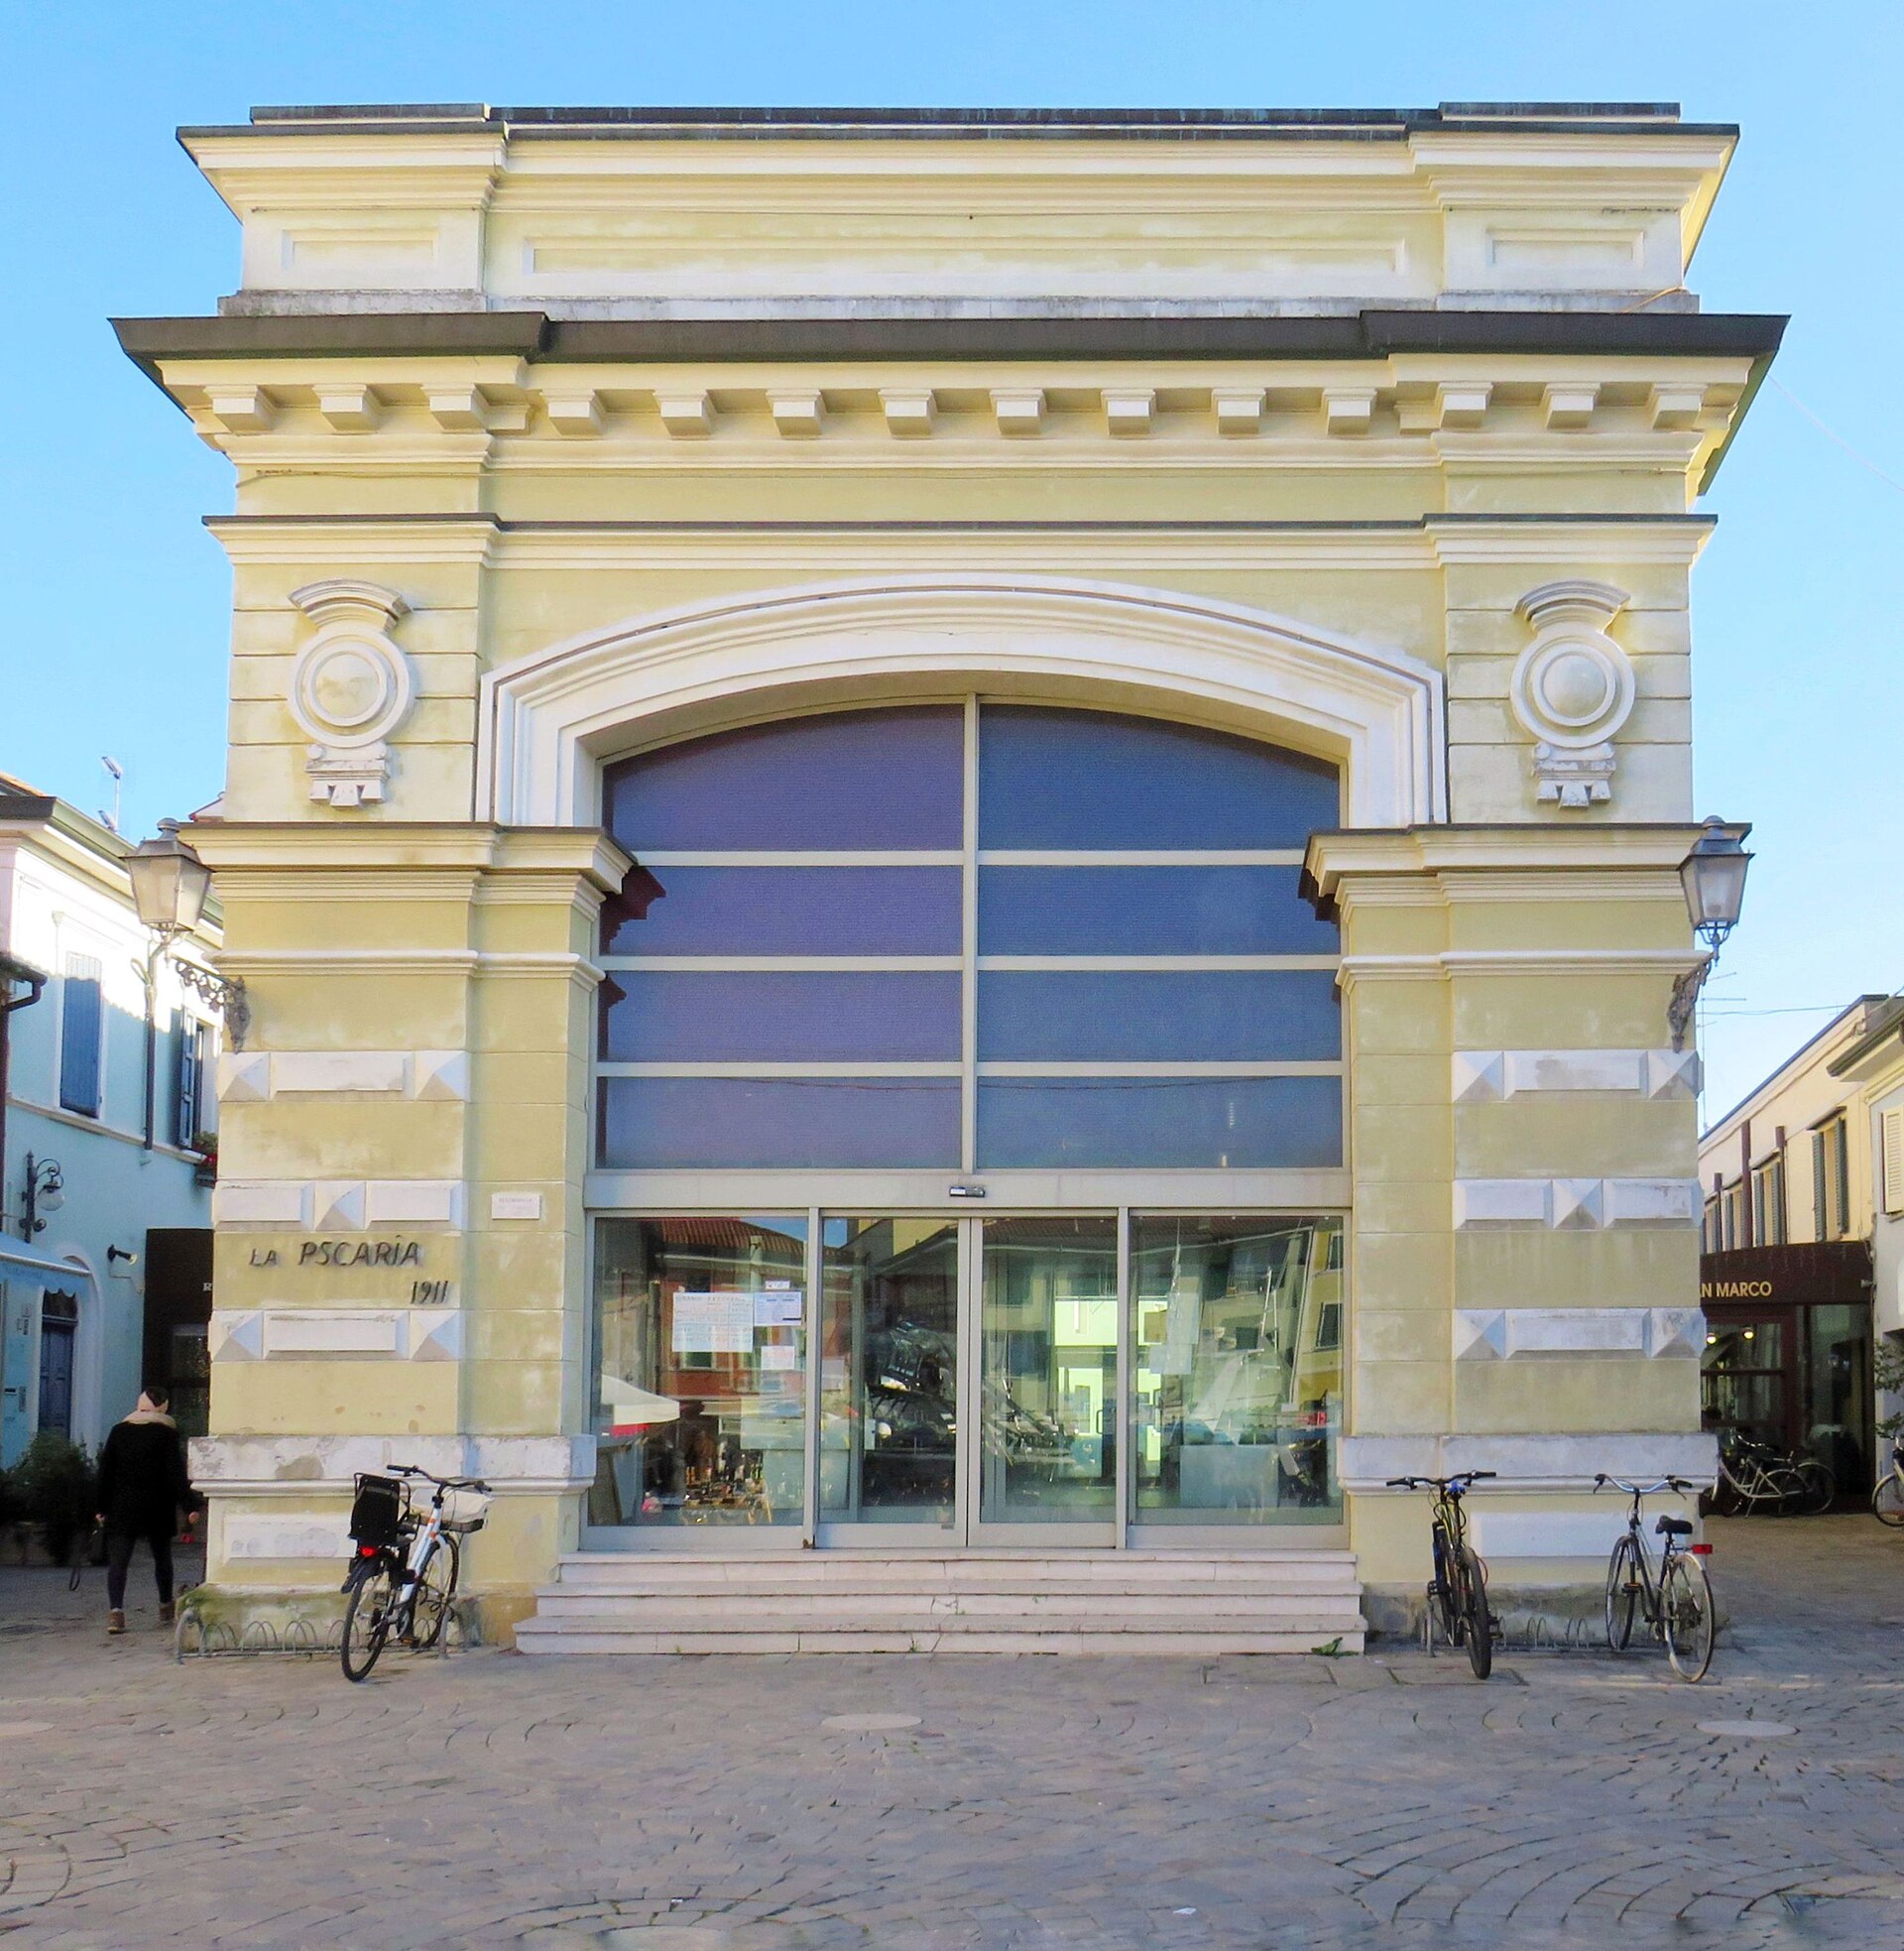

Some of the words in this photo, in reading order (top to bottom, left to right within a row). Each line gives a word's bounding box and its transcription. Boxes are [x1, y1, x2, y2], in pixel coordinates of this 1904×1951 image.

[249, 1248, 278, 1267] LA
[411, 1280, 448, 1304] 1911
[1716, 1280, 1772, 1297] MARCO
